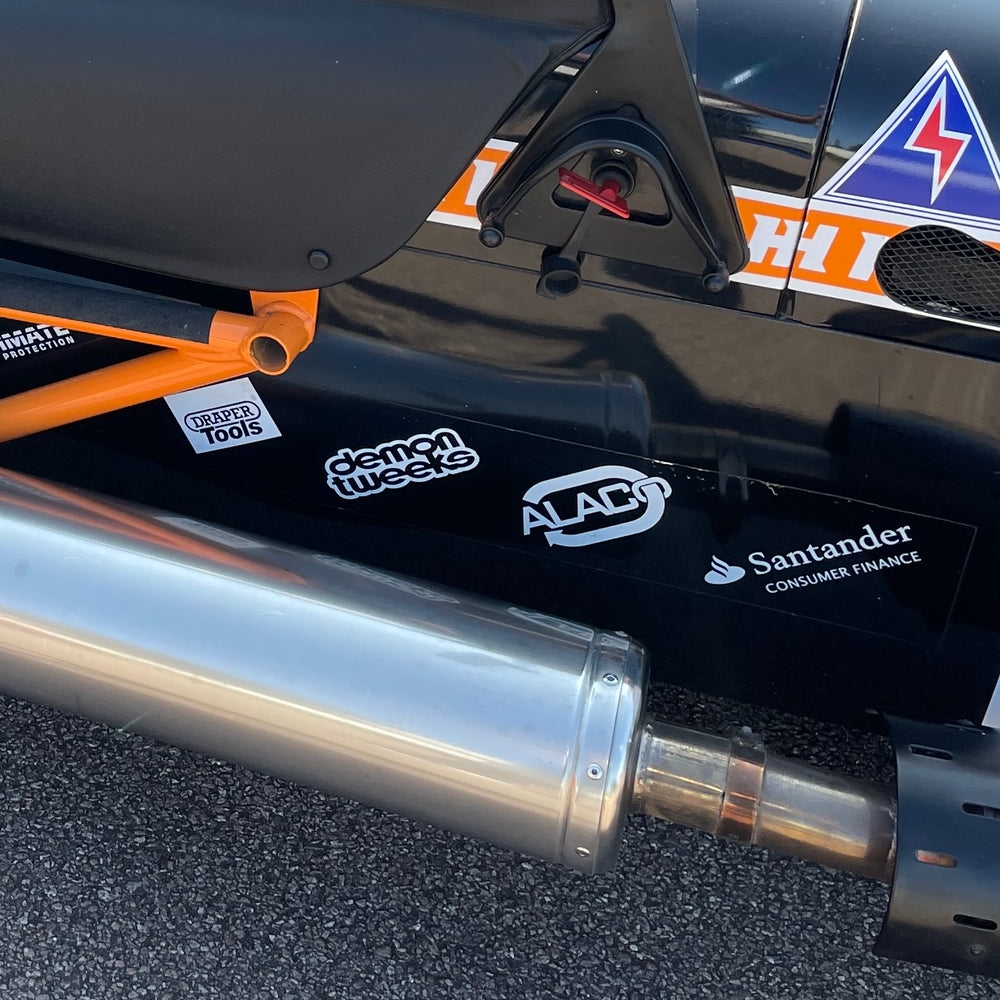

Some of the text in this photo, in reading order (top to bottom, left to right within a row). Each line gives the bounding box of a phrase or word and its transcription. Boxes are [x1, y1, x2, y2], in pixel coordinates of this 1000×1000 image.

[2, 335, 75, 361] PROTECTION
[190, 405, 255, 428] DRAPER
[200, 420, 263, 444] Tools
[329, 432, 460, 475] demon
[332, 451, 475, 496] tweeks
[748, 524, 913, 575] Santander
[765, 551, 922, 593] CONSUMER FINANCE
